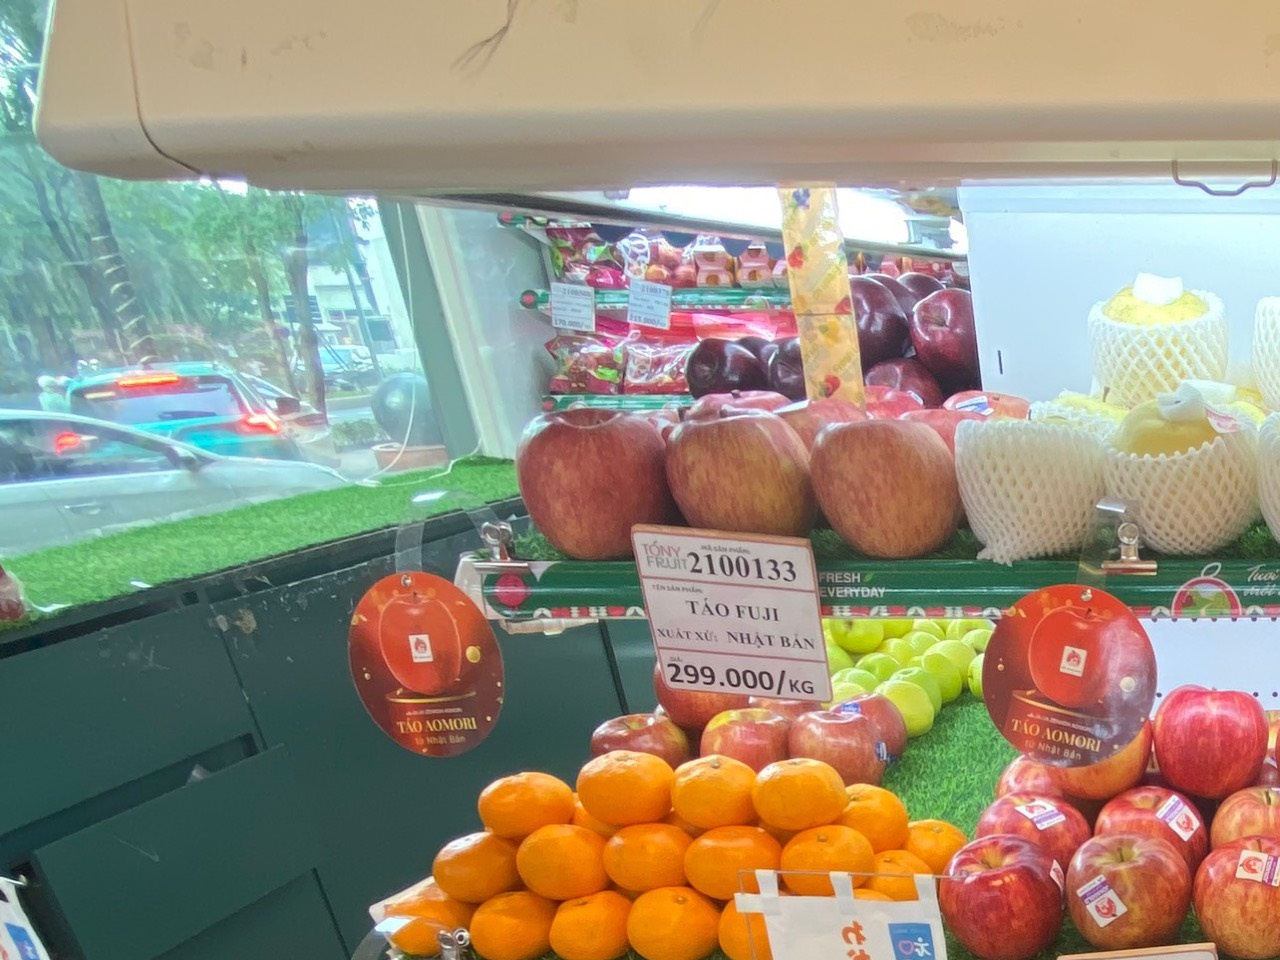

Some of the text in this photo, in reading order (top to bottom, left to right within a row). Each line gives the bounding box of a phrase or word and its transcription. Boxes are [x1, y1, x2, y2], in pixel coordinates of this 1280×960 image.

[647, 557, 687, 570] FRUIT
[687, 551, 797, 582] 2100133
[818, 572, 861, 584] FRESH
[818, 586, 886, 598] EVERYDAY
[686, 598, 781, 621] TÁO FUJI
[667, 663, 814, 695] 299.000/KG
[426, 718, 477, 733] AOMORI
[1042, 729, 1101, 752] AOMORI
